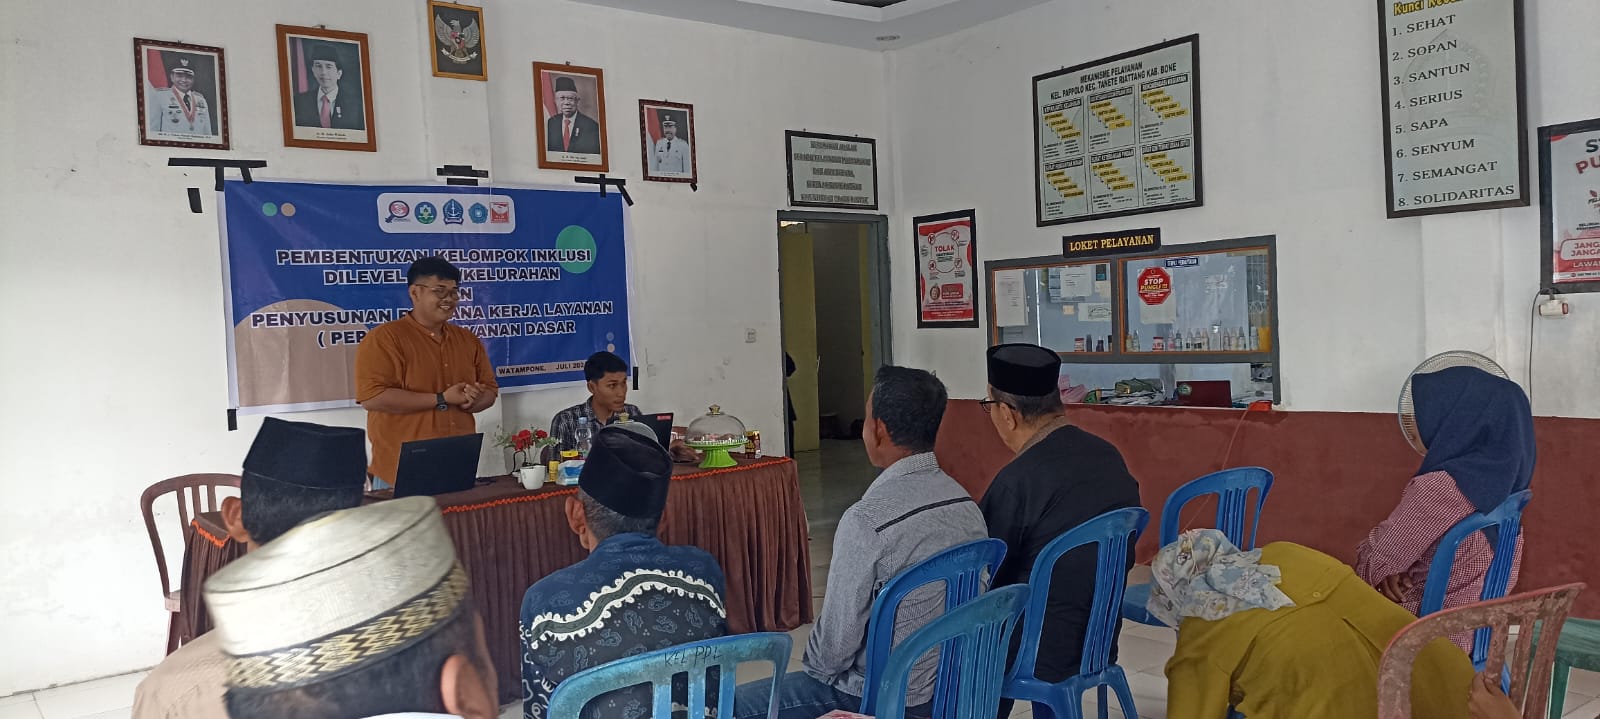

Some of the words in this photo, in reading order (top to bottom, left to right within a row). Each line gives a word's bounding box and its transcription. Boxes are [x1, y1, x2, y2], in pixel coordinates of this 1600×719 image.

[1394, 0, 1424, 16] Kunci
[1392, 27, 1402, 36] 1.
[1406, 14, 1456, 33] SEHAT
[1392, 52, 1403, 61] 2.
[1407, 40, 1458, 58] SOPAN
[1080, 68, 1111, 83] MEKANISME
[1111, 61, 1143, 76] PELAYANAN
[1097, 77, 1118, 89] TANETE
[1118, 71, 1146, 86] RIATTANG
[1160, 63, 1177, 75] BONE
[1393, 76, 1404, 85] 3.
[1408, 63, 1471, 83] SANTUN
[1394, 100, 1405, 109] 4.
[1409, 89, 1463, 107] SERIUS
[1395, 125, 1406, 134] 5.
[1410, 118, 1448, 132] SAPA
[1396, 149, 1407, 158] 6.
[1411, 139, 1475, 156] SENYUM
[1586, 138, 1600, 153] S
[1397, 173, 1408, 182] 7.
[1412, 161, 1498, 181] SEMANGAT
[1398, 198, 1409, 207] 8.
[1413, 185, 1514, 205] SOLIDARITAS
[935, 244, 955, 252] TOLAK
[1069, 240, 1098, 252] LOKET
[1101, 234, 1154, 249] PELAYANAN
[276, 249, 429, 265] PEMBENTUKAN
[433, 248, 529, 264] KELOMPOK
[531, 248, 592, 263] INKLUSI
[323, 268, 408, 285] DILEVEL
[251, 309, 393, 329] PENYUSUNAN
[488, 302, 542, 319] KERJA
[544, 301, 613, 317] LAYANAN
[525, 320, 577, 335] DASAR
[555, 362, 571, 370] JULI
